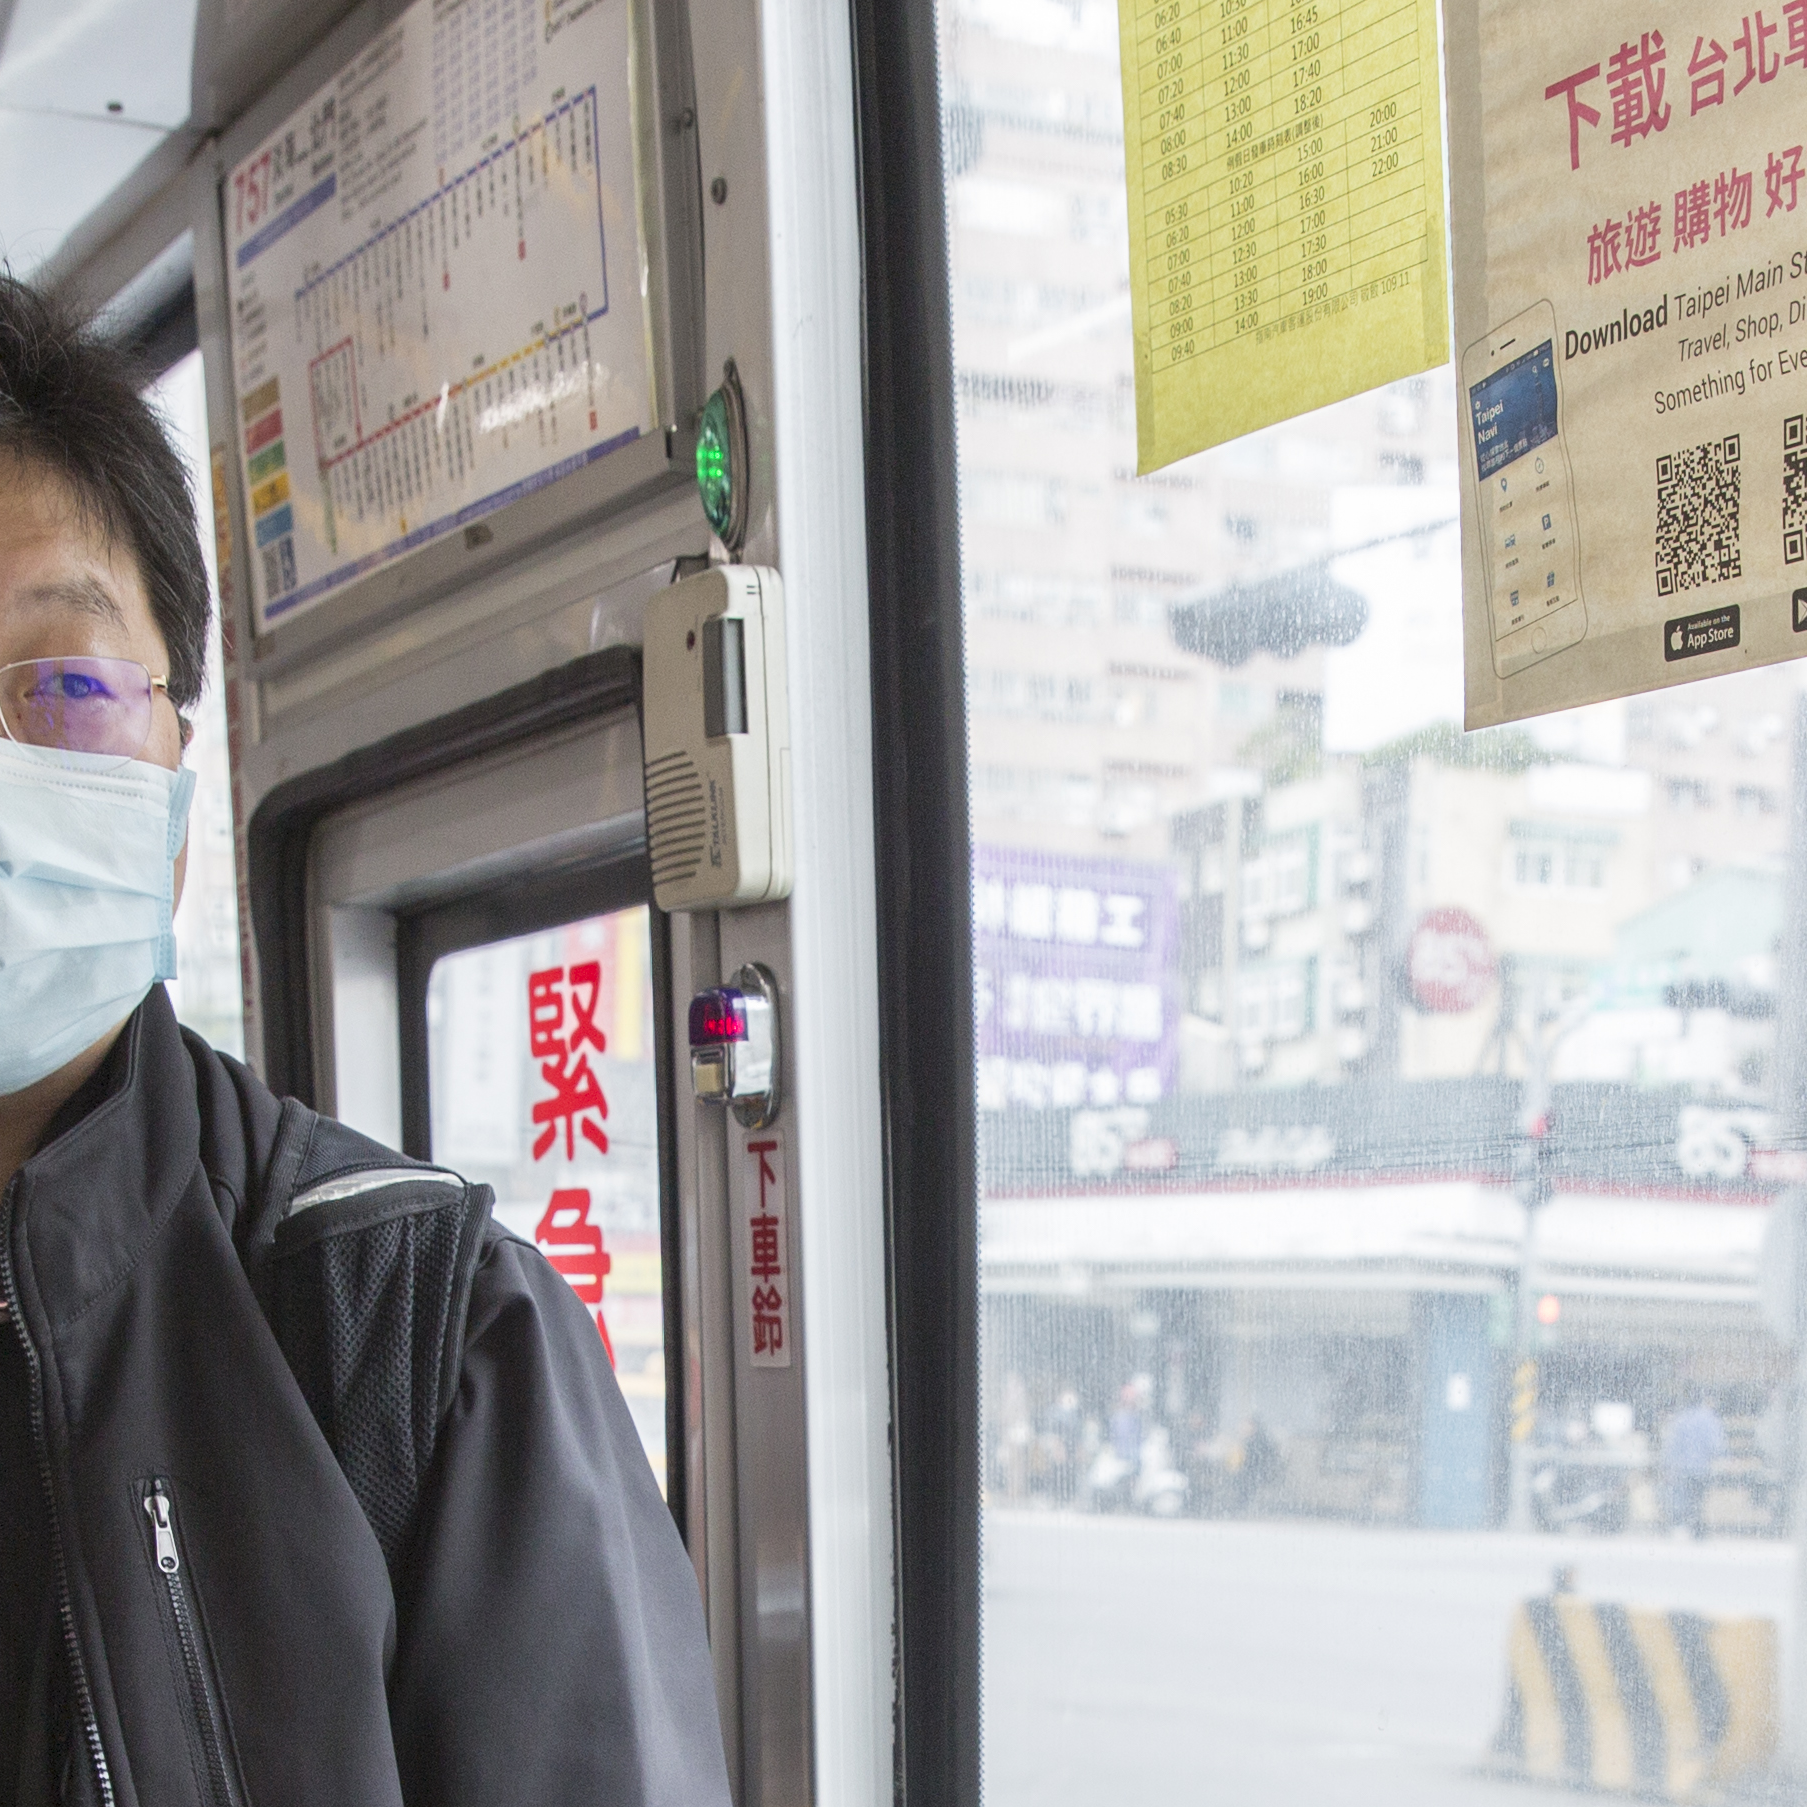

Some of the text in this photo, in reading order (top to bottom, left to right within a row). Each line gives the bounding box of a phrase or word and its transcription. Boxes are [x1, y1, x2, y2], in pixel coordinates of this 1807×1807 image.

[1155, 2, 1180, 29] 06:20
[1290, 5, 1318, 34] 16:45
[1156, 27, 1181, 54] 06:40
[1221, 16, 1248, 45] 11:00
[1223, 43, 1249, 70] 11:30
[1292, 32, 1320, 61] 17:00
[1157, 52, 1182, 80] 07:00
[1293, 59, 1321, 88] 17:40
[1158, 78, 1184, 105] 07:20
[1224, 69, 1250, 97] 12:00
[1225, 95, 1251, 123] 13:00
[1294, 86, 1322, 115] 18:20
[1544, 28, 1671, 171] 下載
[1160, 103, 1185, 130] 07:40
[1369, 101, 1397, 128] 20:00
[1161, 129, 1186, 155] 08:00
[1226, 121, 1252, 149] 14:00
[1371, 127, 1398, 153] 21:00
[1298, 137, 1323, 162] 15:00
[1162, 154, 1187, 181] 08:30
[1299, 161, 1324, 186] 16:00
[1372, 151, 1399, 177] 22:00
[1230, 170, 1253, 195] 10:20
[1231, 194, 1254, 218] 11:00
[1300, 185, 1325, 210] 16:30
[1165, 202, 1188, 226] 05:30
[1301, 209, 1325, 234] 17:00
[1587, 201, 1662, 286] 旅遊
[1673, 167, 1753, 254] 購物
[1166, 225, 1189, 248] 06:20
[1232, 217, 1255, 242] 12:00
[1167, 248, 1190, 271] 07:00
[1233, 241, 1256, 265] 12:30
[1302, 234, 1326, 259] 17:30
[1168, 271, 1191, 294] 07:40
[1234, 265, 1257, 288] 13:00
[1302, 258, 1327, 282] 18:00
[1169, 293, 1192, 316] 08:20
[1235, 288, 1258, 312] 13:30
[1303, 282, 1328, 306] 19:00
[1235, 311, 1258, 335] 14:00
[1565, 294, 1668, 360] Download
[1674, 275, 1731, 322] Taipei
[1736, 261, 1784, 299] Main
[1170, 316, 1193, 339] 09:00
[1678, 323, 1731, 364] Travel,
[1735, 306, 1784, 344] Shop,
[1171, 339, 1194, 362] 09:40
[1654, 363, 1746, 414] Something
[1749, 356, 1773, 383] for
[1475, 399, 1504, 426] Taipei
[1477, 421, 1498, 445] Navi
[1687, 614, 1730, 631] Available on the
[1687, 625, 1734, 649] App Store
[746, 1140, 784, 1356] 下車鈴
